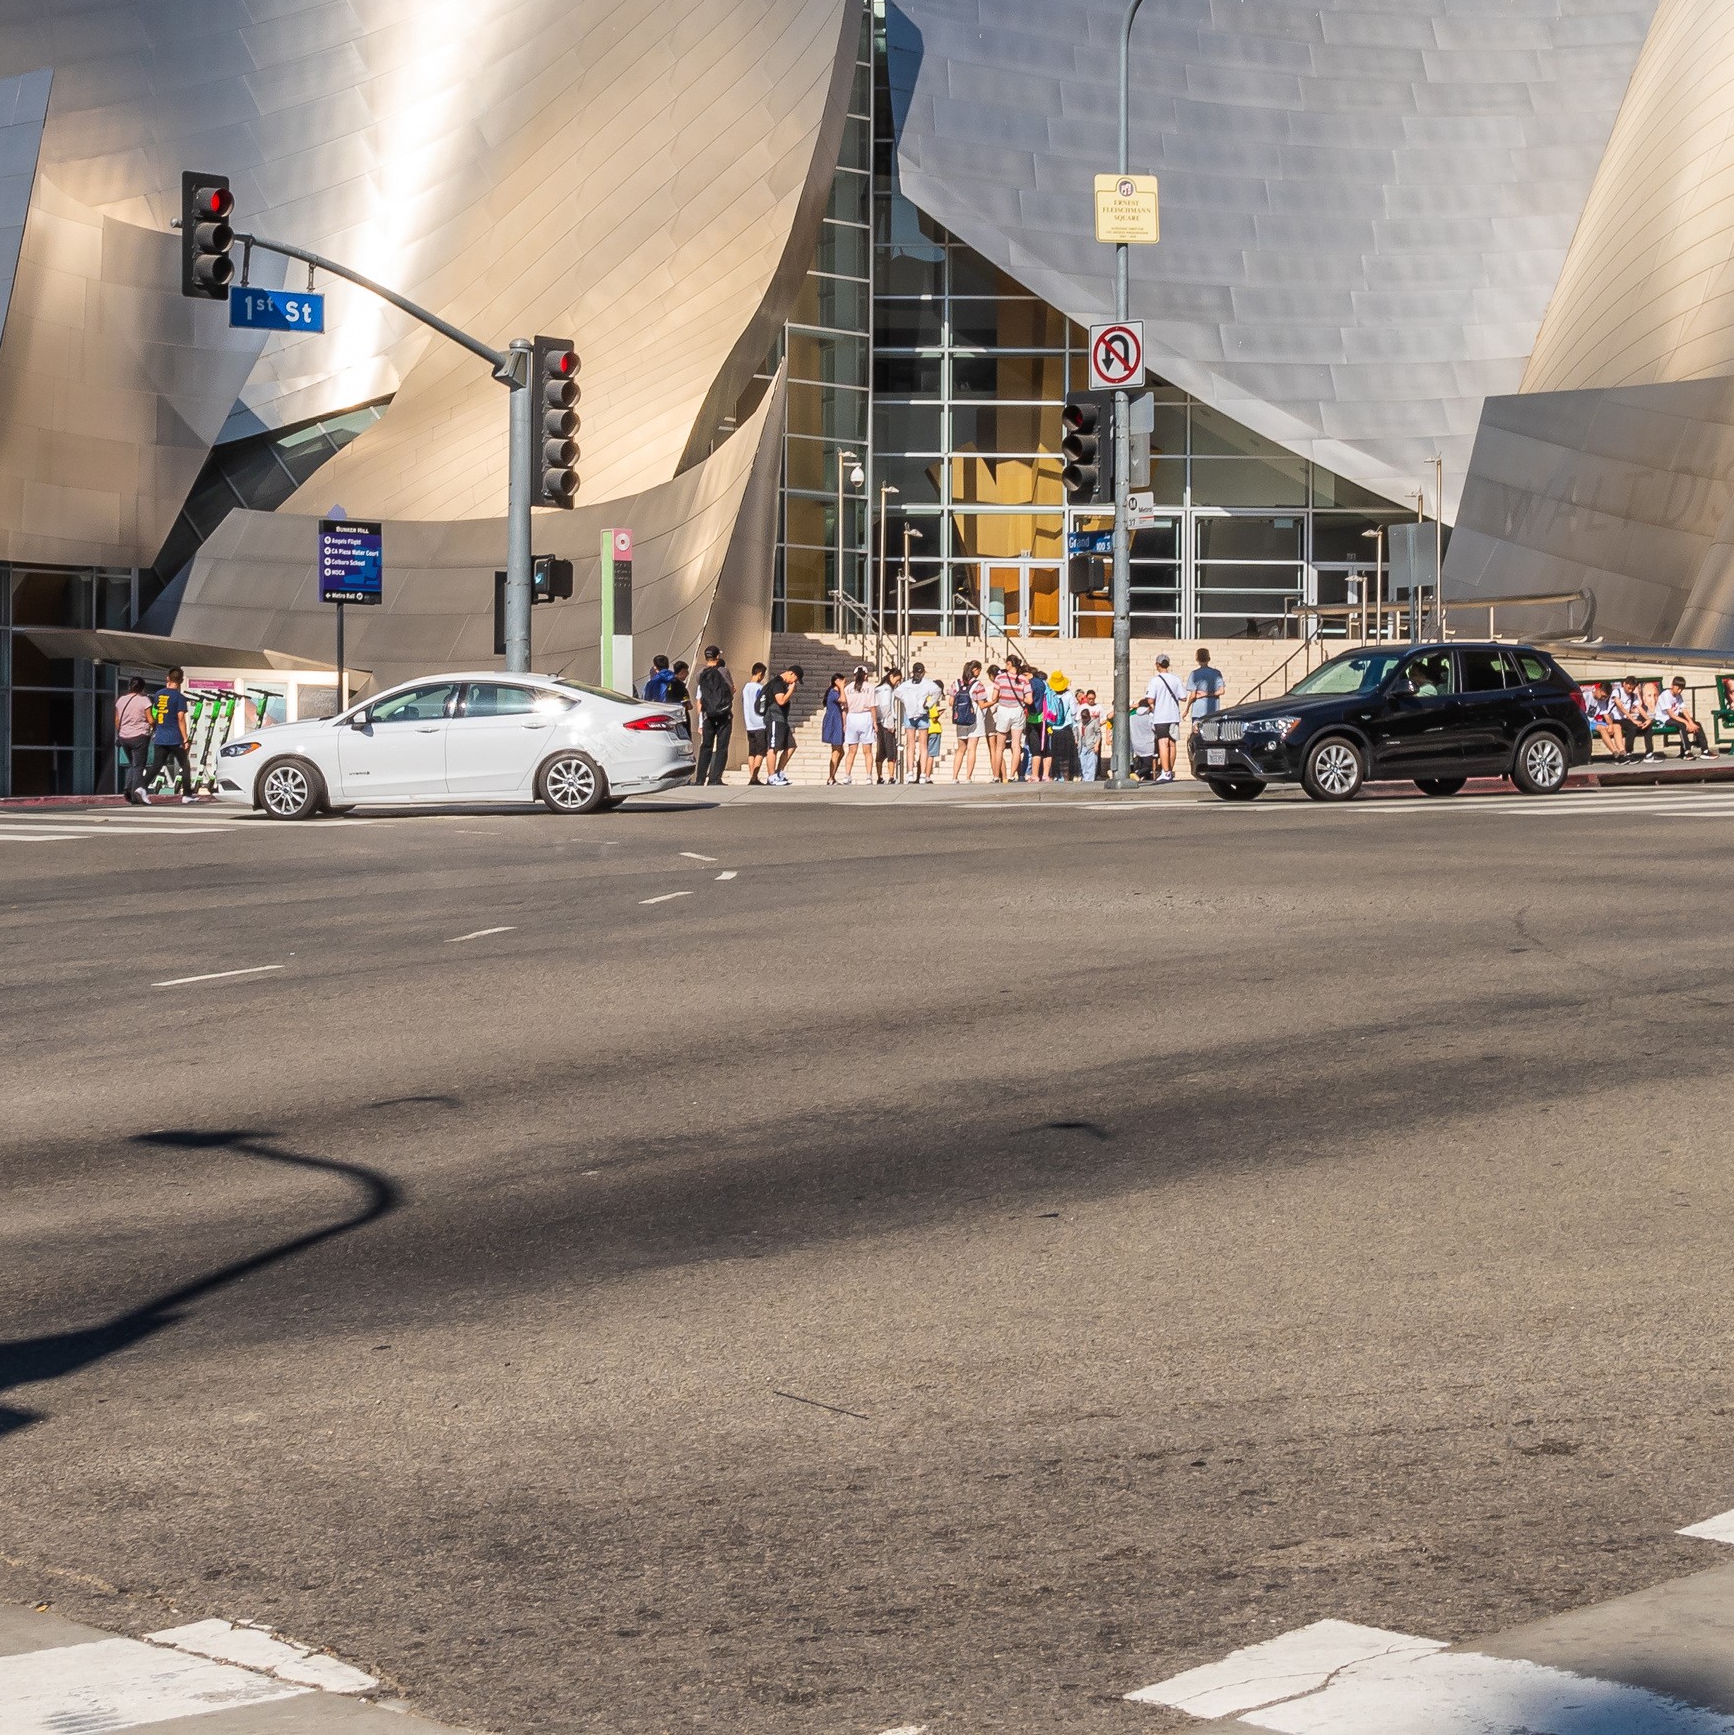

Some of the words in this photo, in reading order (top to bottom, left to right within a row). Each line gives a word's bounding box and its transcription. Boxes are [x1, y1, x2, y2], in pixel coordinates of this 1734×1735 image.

[245, 296, 273, 320] 1st
[285, 301, 312, 323] St
[1068, 536, 1090, 548] Grand
[1096, 542, 1105, 550] 100
